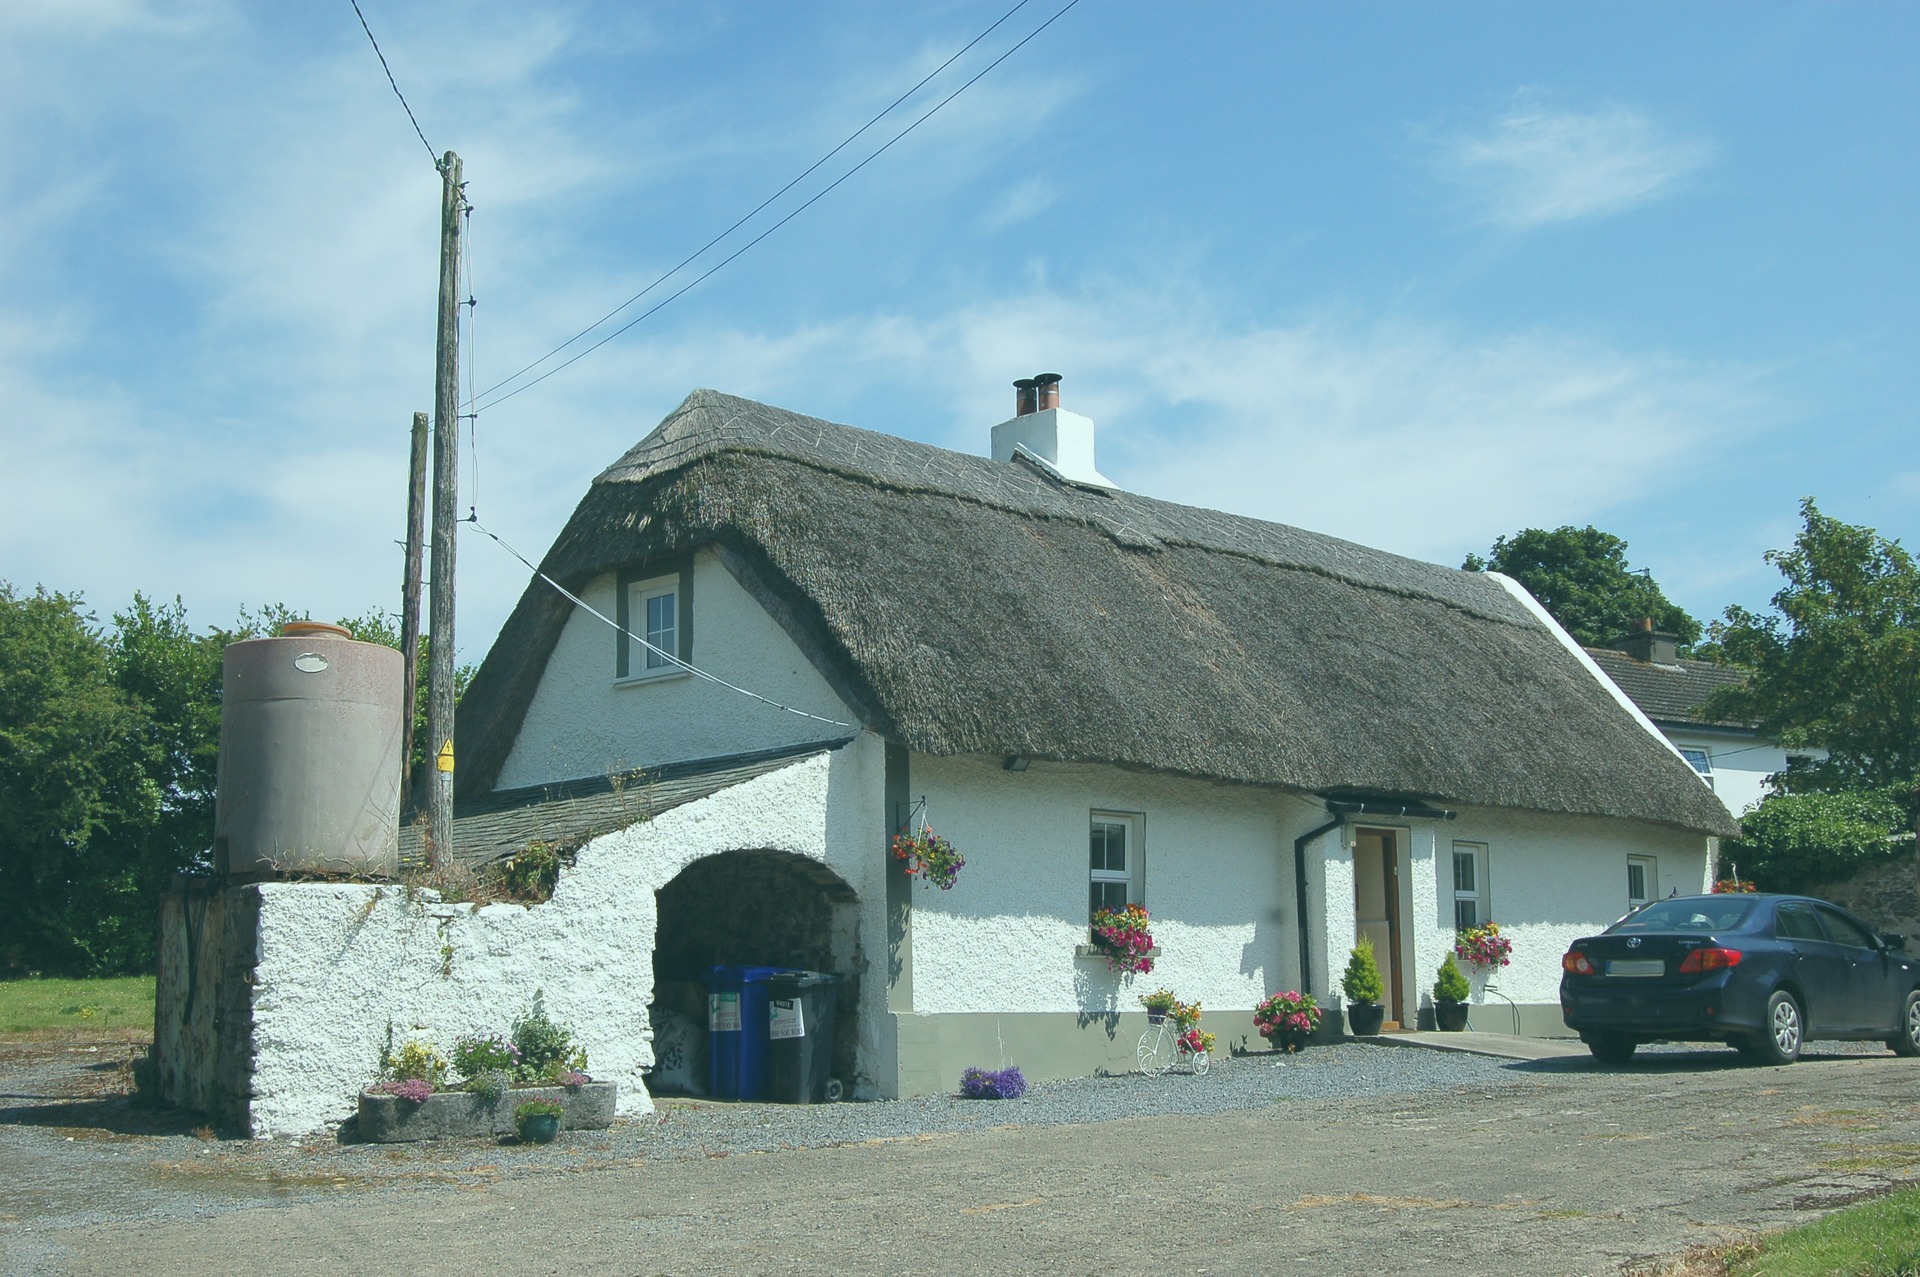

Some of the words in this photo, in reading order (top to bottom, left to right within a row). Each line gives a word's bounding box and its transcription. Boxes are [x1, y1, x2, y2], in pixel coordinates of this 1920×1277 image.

[776, 1000, 791, 1008] WASTE
[780, 1029, 790, 1037] 500
[791, 1027, 803, 1036] 800
